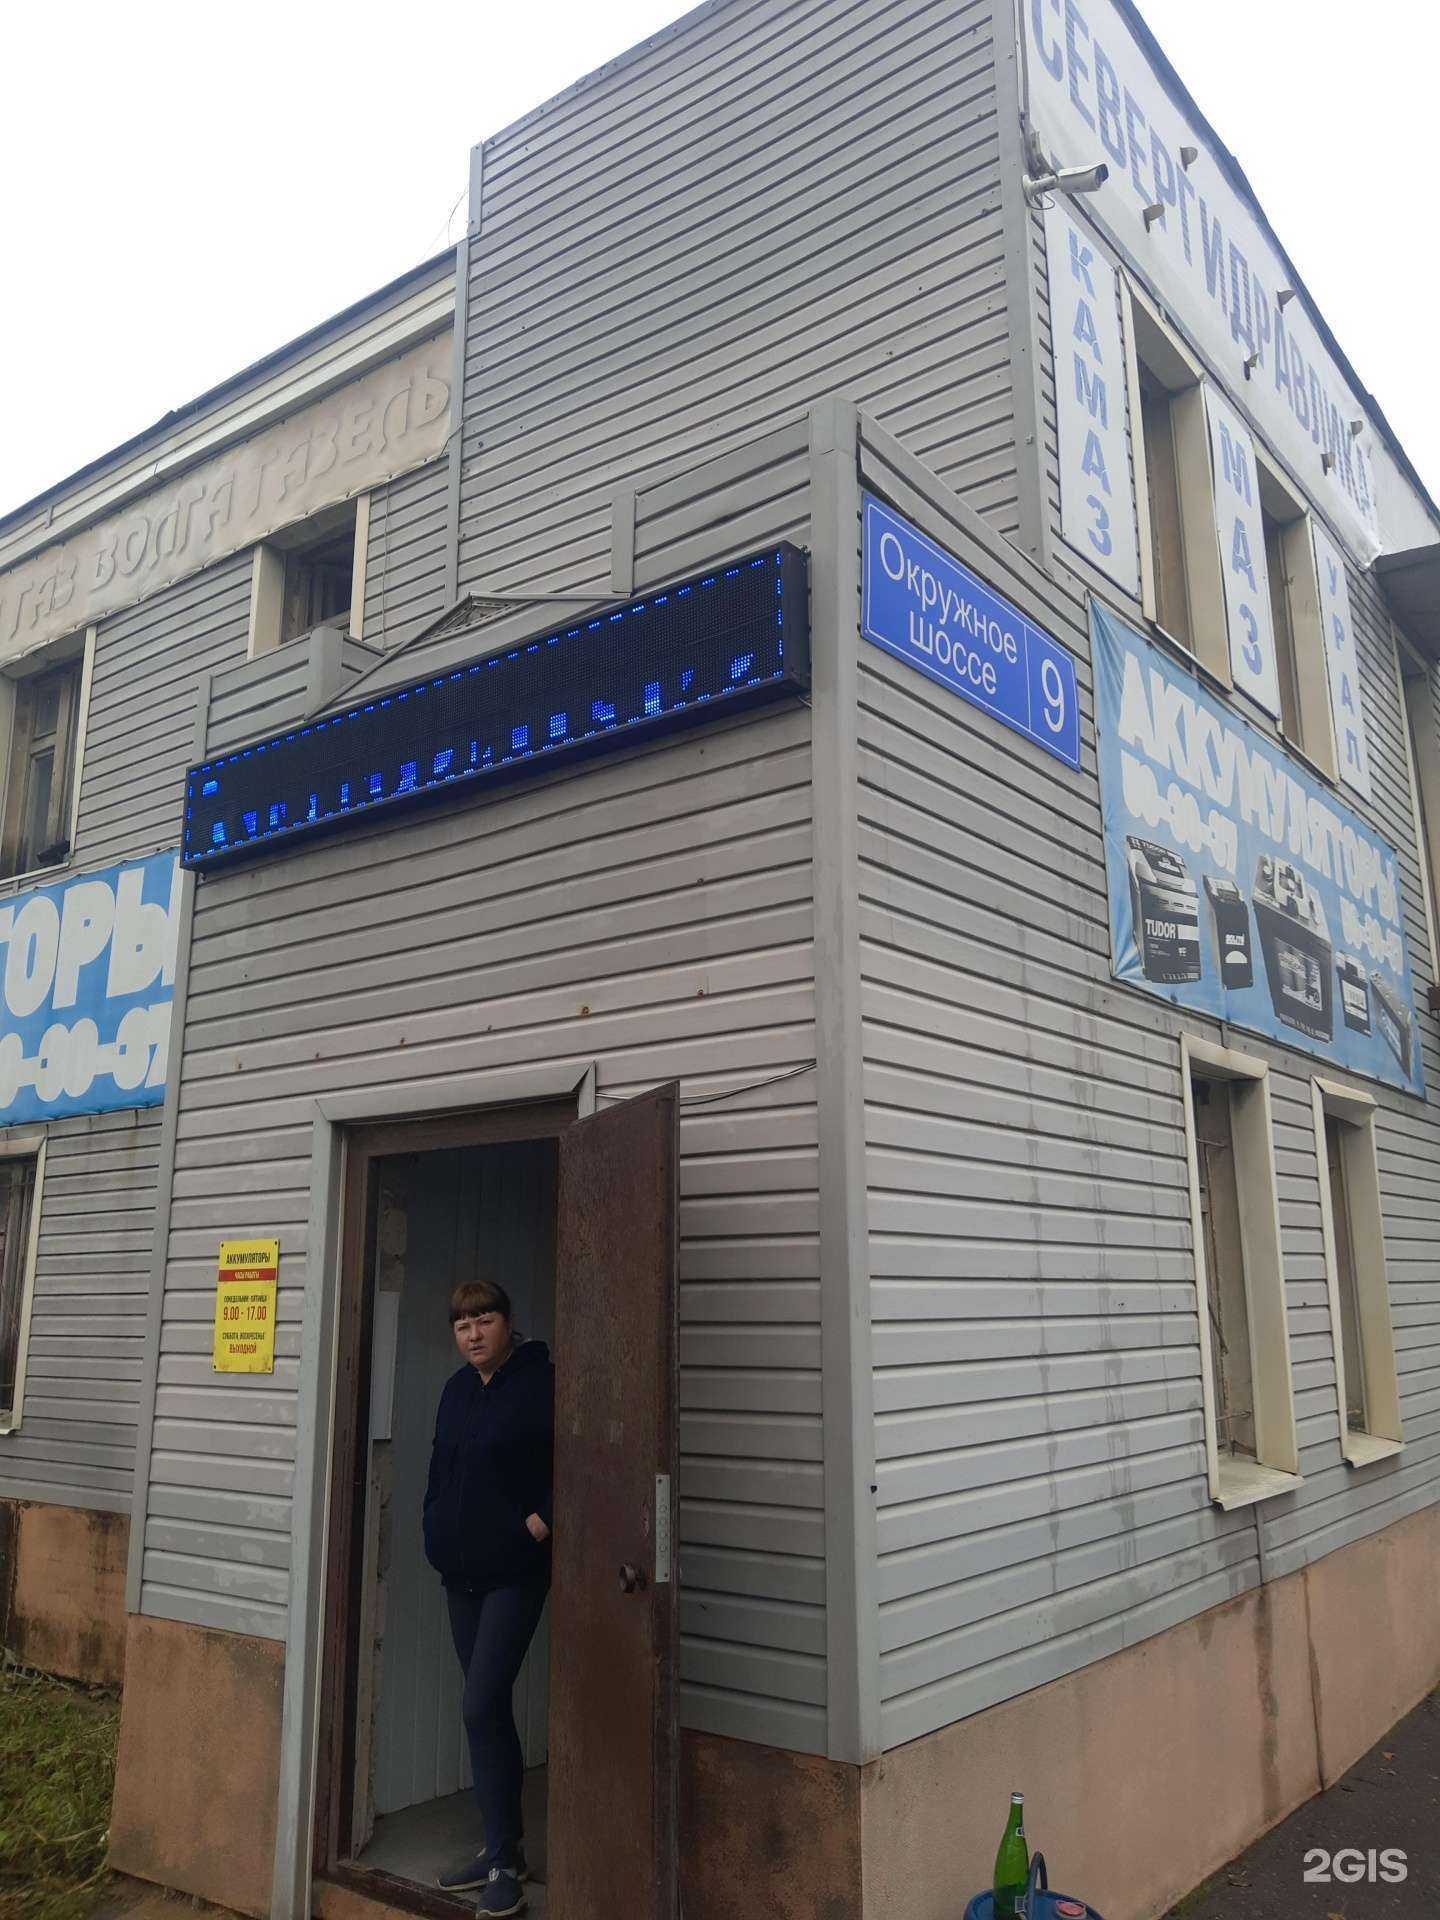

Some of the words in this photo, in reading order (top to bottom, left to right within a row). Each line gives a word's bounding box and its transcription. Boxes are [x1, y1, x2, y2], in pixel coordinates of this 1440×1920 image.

[1067, 227, 1113, 557] КАМАЗ
[880, 532, 1018, 664] Окружное
[1218, 419, 1264, 676] МАЗ
[1041, 658, 1065, 733] 9
[1326, 556, 1362, 773] УРАЛ
[1118, 651, 1399, 930] АККУМУЛЯТОРЫ
[1145, 918, 1177, 940] TUDOR
[223, 1306, 240, 1321] 9.00
[246, 1305, 267, 1321] 17.00
[226, 1252, 271, 1264] АККУМУЛЯТОРЫ
